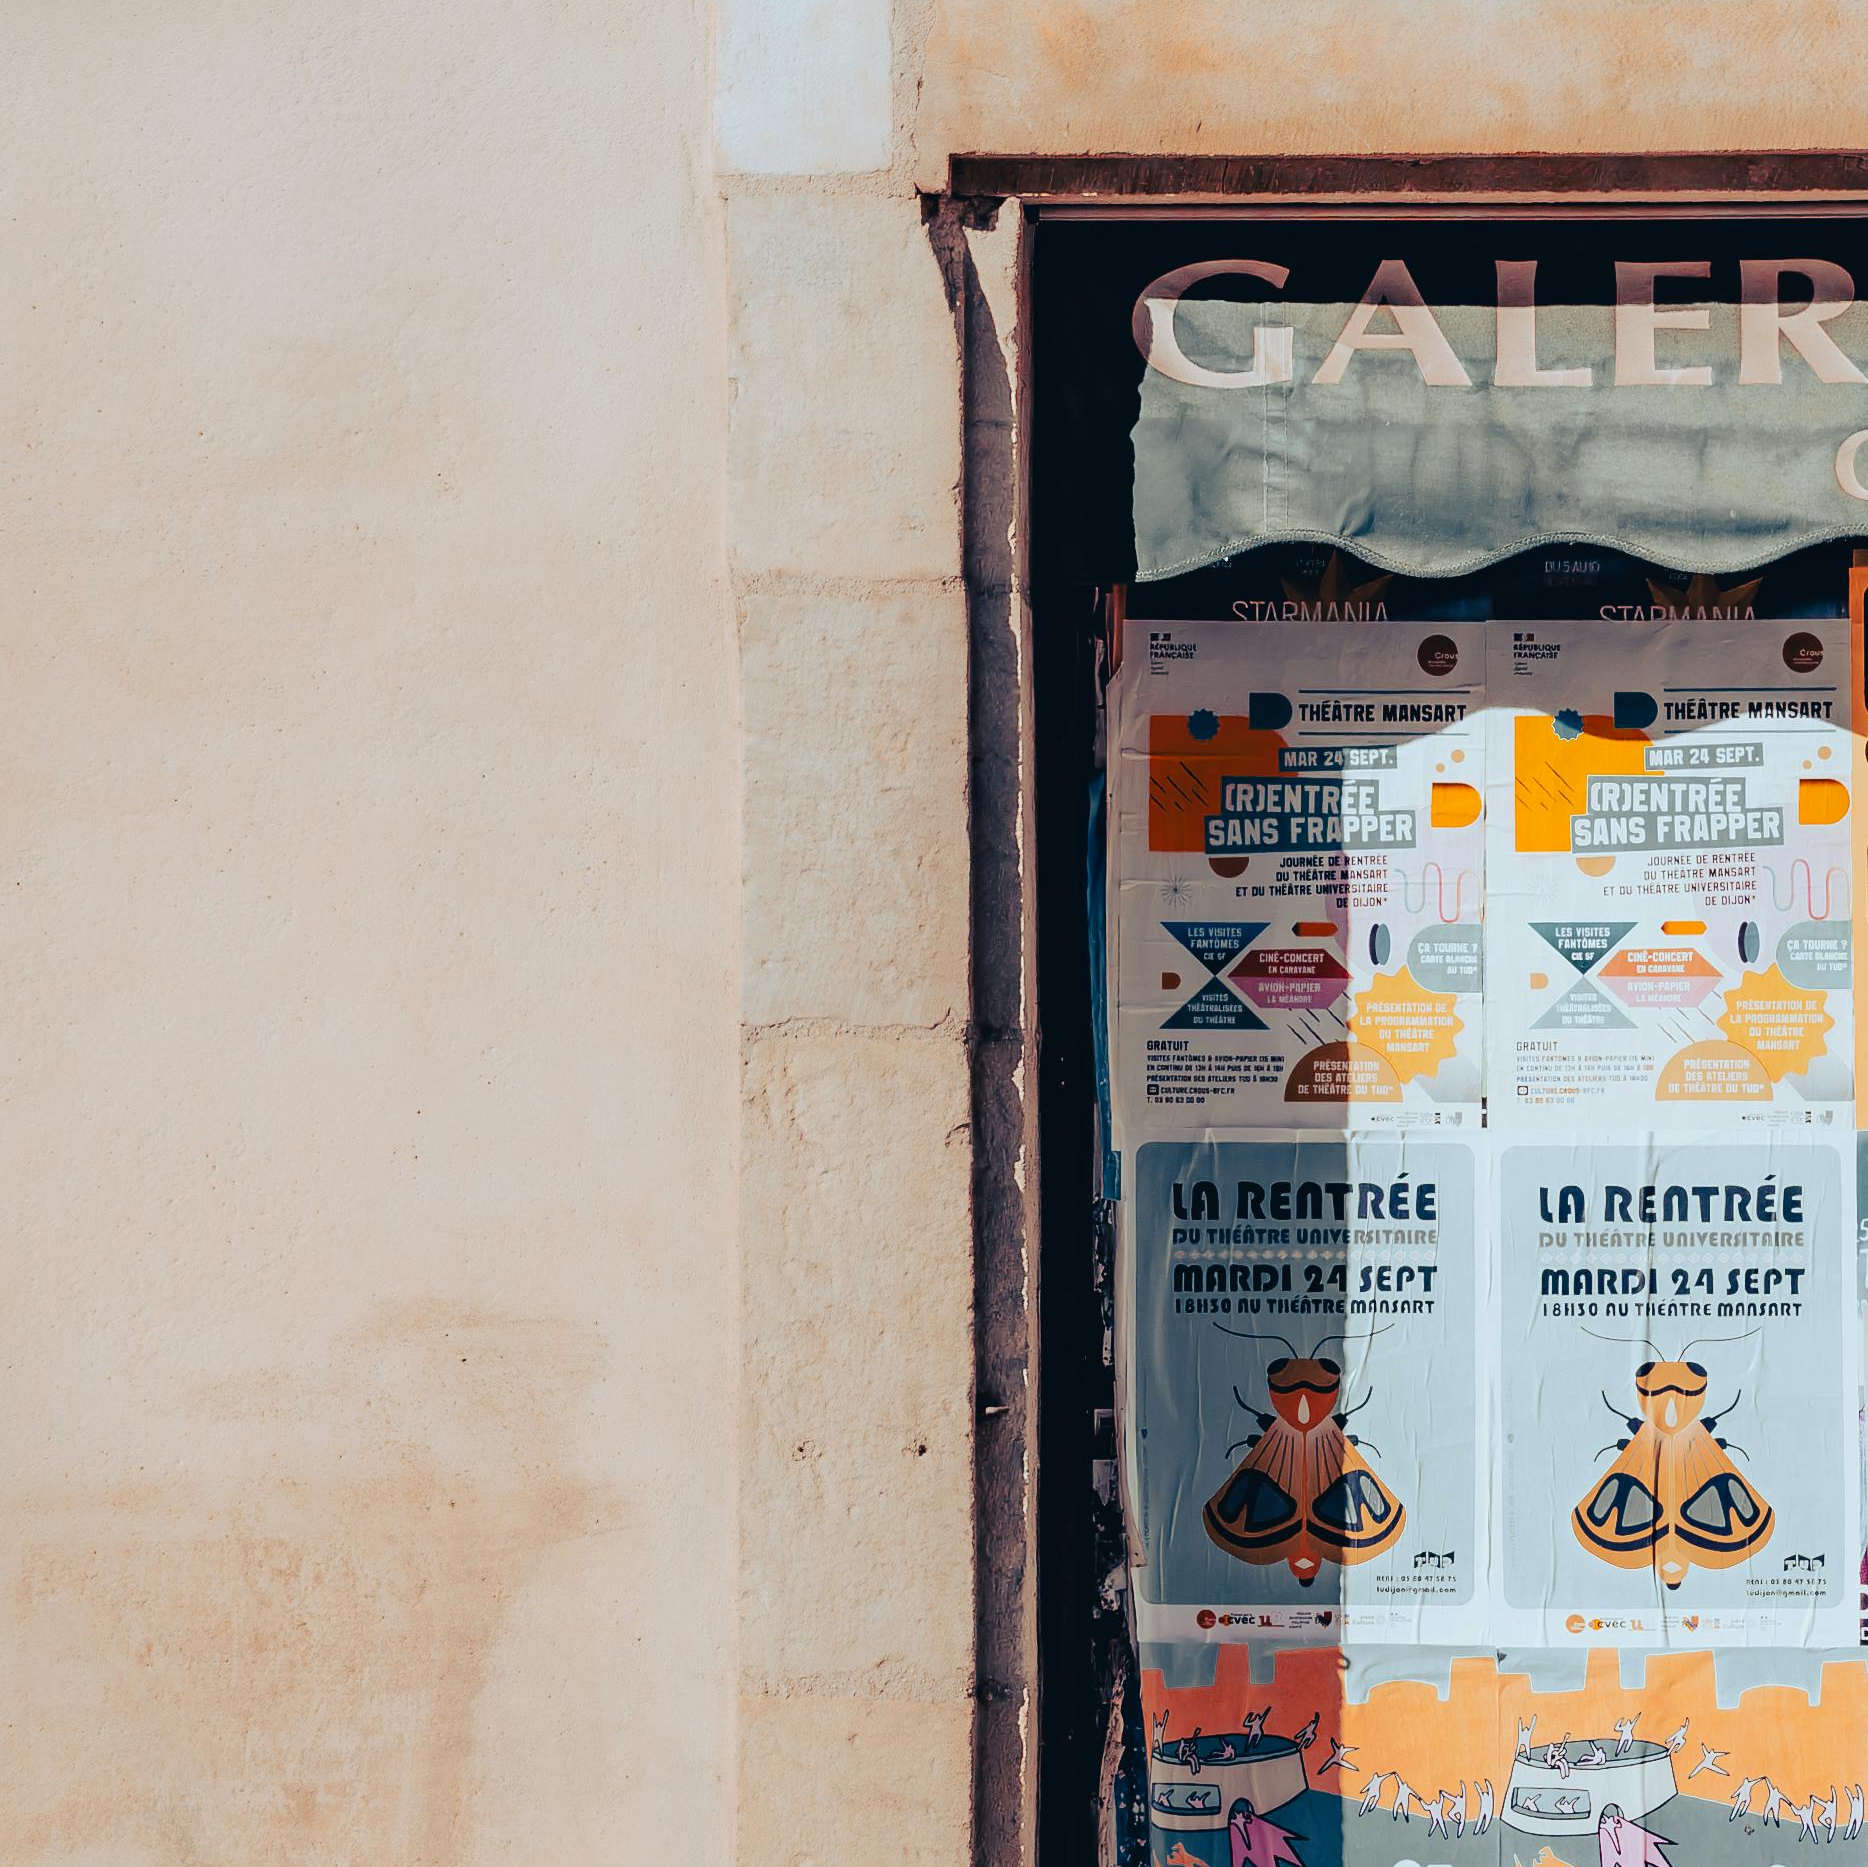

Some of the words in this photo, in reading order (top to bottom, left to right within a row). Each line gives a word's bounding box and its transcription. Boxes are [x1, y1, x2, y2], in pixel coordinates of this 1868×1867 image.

[1299, 699, 1375, 722] THÉÂTRE
[1382, 703, 1467, 722] MANSART
[1664, 698, 1740, 720] THÉÂTRE
[1748, 700, 1833, 720] MANSART
[1650, 750, 1685, 766] MAR
[1690, 748, 1711, 764] 24
[1716, 746, 1760, 764] SEPT.
[1226, 780, 1376, 814] (R)ENTRÉE
[1591, 778, 1742, 812] (R)ENTRÉE
[1209, 818, 1279, 846] SANS
[1291, 814, 1413, 844] FRAPPER
[1574, 817, 1647, 846] SANS
[1657, 812, 1781, 841] FRAPPER
[1147, 1041, 1189, 1051] GRATUIT
[1172, 1182, 1219, 1220] LA
[1236, 1172, 1437, 1221] RENTRÉE
[1539, 1185, 1587, 1223] LA
[1604, 1175, 1803, 1223] RENTRÉE
[1539, 1232, 1568, 1248] DU
[1663, 1232, 1805, 1248] UNIVERSITAIRE
[1173, 1264, 1291, 1293] MARDI
[1305, 1264, 1347, 1292] 24
[1360, 1264, 1438, 1292] SEPT
[1541, 1268, 1658, 1296] MARDI
[1671, 1269, 1714, 1295] 24
[1726, 1268, 1806, 1295] SEPT
[1542, 1301, 1598, 1317] 18H30
[1605, 1301, 1629, 1317] AU
[1717, 1301, 1802, 1317] MANSART
